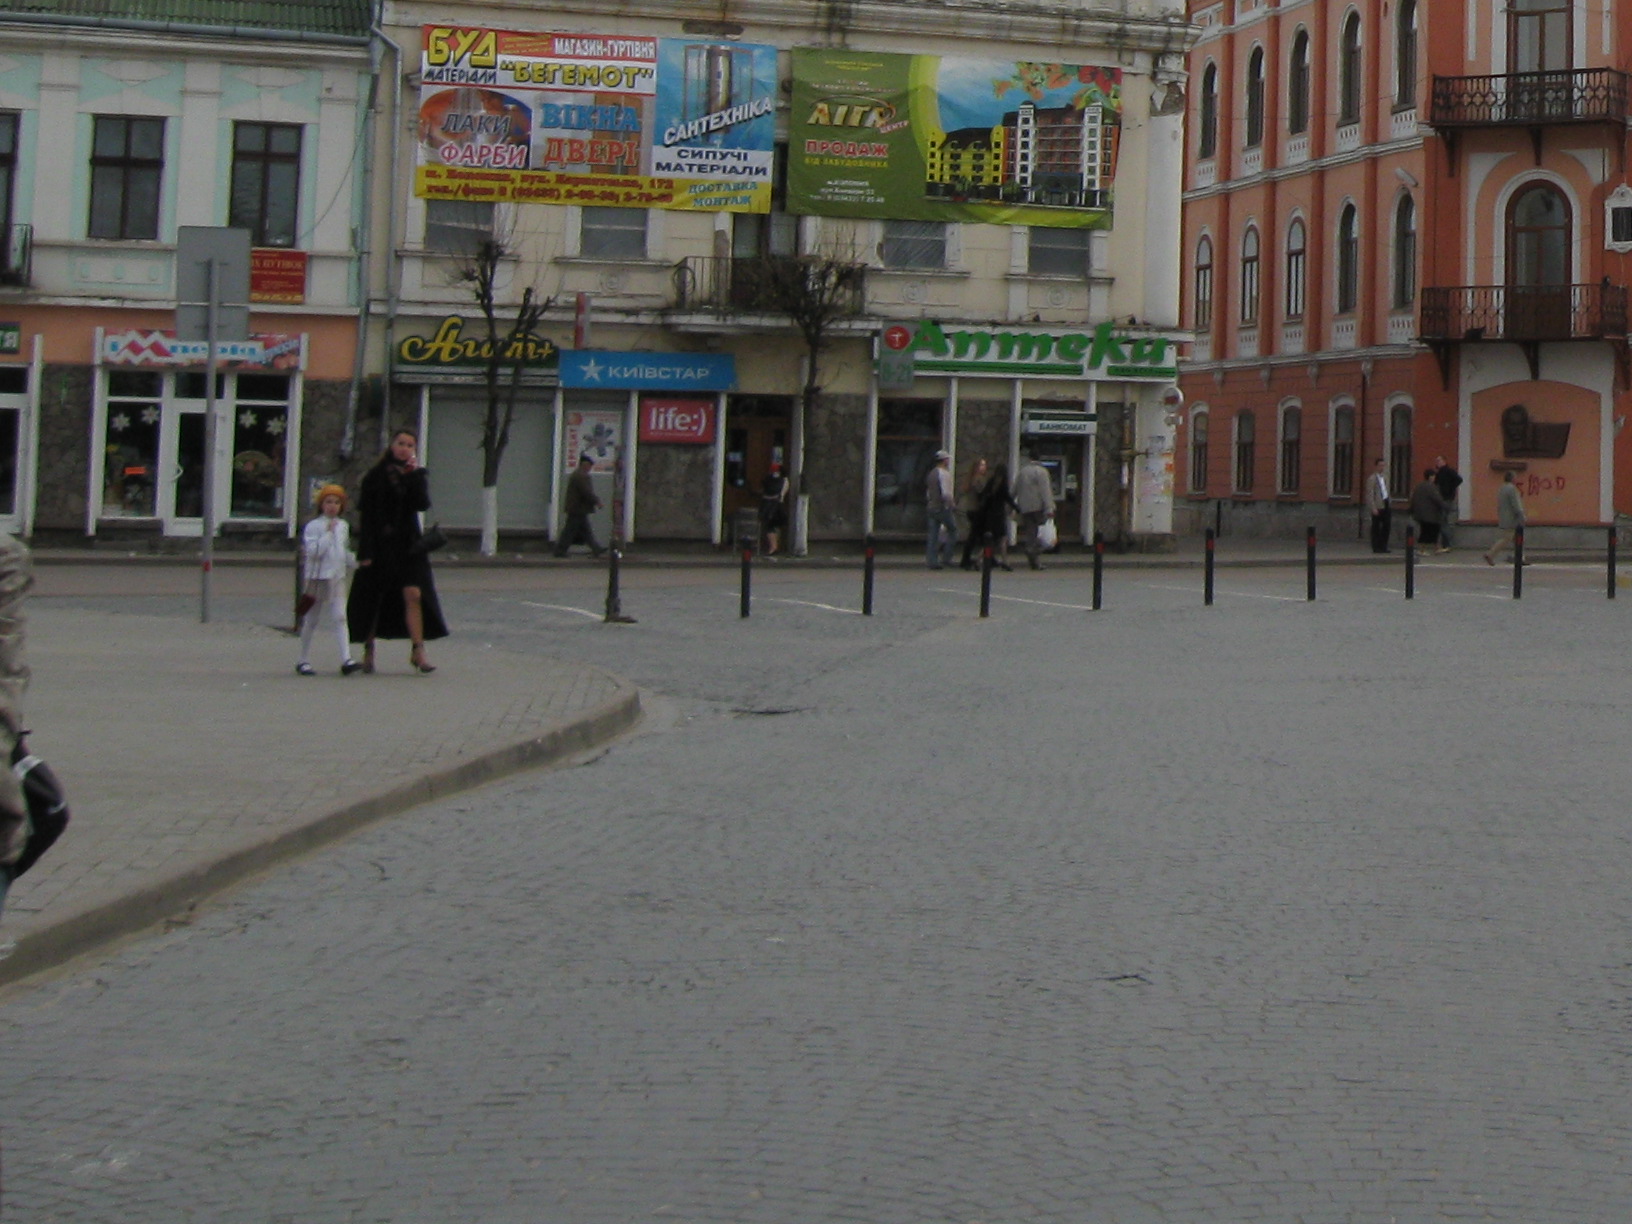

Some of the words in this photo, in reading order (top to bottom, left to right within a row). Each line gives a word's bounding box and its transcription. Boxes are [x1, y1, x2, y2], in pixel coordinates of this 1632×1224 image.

[428, 28, 497, 68] БУД
[555, 38, 656, 58] МАГАЗИН-ГУРТІВНЯ
[423, 67, 497, 84] МАТЕРІАЛИ
[441, 112, 512, 134] ЛАКИ
[541, 103, 642, 132] ВІКНА
[663, 96, 772, 147] САНТЕХНІКА
[440, 142, 529, 168] ФАРБИ
[544, 137, 639, 169] ДВЕРІ
[677, 149, 749, 162] СИПУЧІ
[805, 139, 889, 158] ПРОДАЖ
[655, 162, 767, 176] МАТЕРІАЛИ
[905, 320, 1170, 369] Аптека
[607, 363, 710, 380] КИЇВСТАР
[650, 407, 708, 437] life:)
[1039, 422, 1088, 432] БАНКОМАТ
